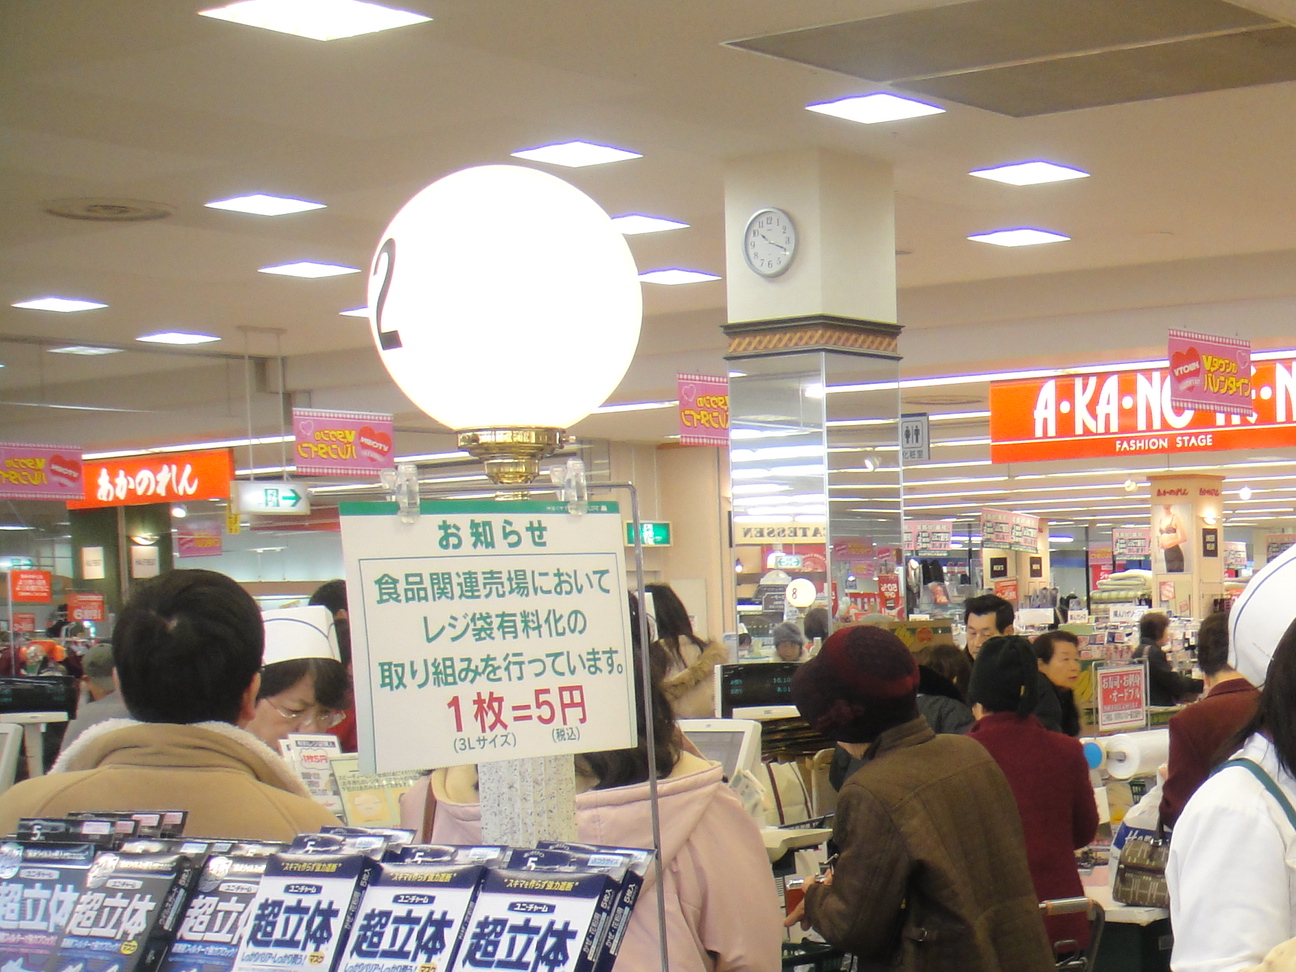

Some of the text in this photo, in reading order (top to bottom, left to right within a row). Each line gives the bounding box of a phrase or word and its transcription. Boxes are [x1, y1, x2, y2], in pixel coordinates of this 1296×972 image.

[372, 237, 403, 351] 2
[1115, 434, 1214, 452] FASHION STAGE
[97, 463, 199, 502] あかのれん
[437, 518, 549, 551] お知らせ
[374, 567, 612, 606] 食品関連売場において
[422, 608, 588, 645] レジ袋有料化の
[378, 647, 625, 692] 取り組みを行っています。
[453, 731, 518, 754] (3Lサイズ)
[551, 726, 582, 744] (税込)
[65, 891, 157, 942] 超立体
[246, 898, 340, 953] 超立体
[350, 908, 455, 965] 超立体
